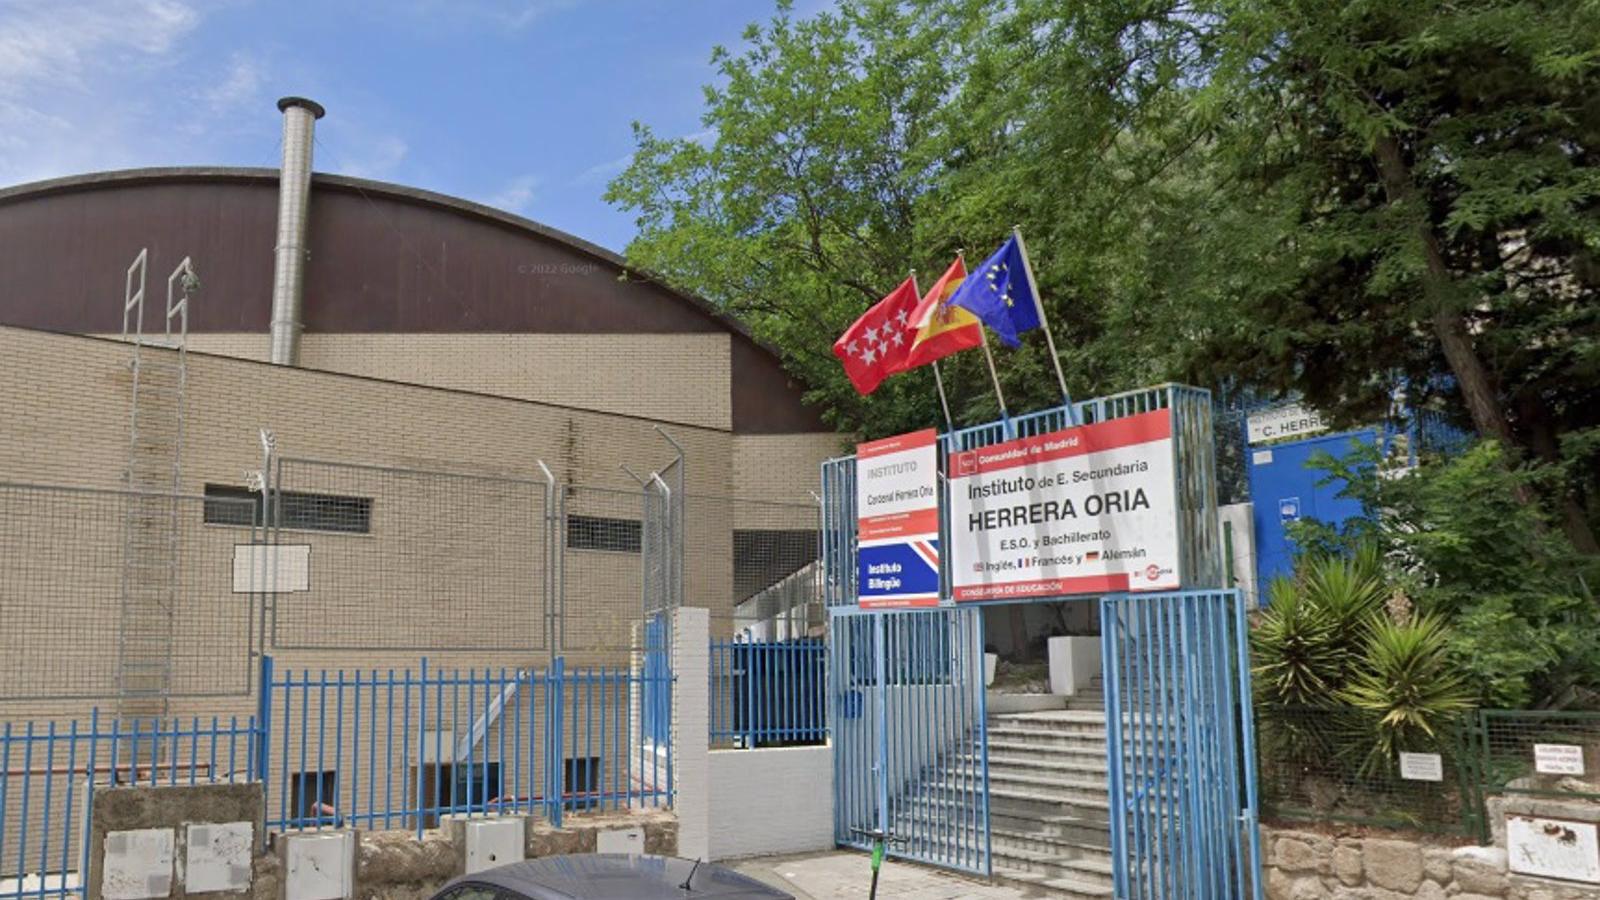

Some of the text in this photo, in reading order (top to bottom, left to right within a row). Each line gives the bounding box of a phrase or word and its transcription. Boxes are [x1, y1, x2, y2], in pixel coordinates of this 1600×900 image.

[979, 447, 1028, 465] Comunidad
[1030, 444, 1042, 454] de
[1044, 436, 1079, 452] Madrid
[867, 460, 918, 480] INSTITUTO
[968, 460, 1149, 499] Instituto de E. Secundaria
[867, 485, 934, 506] Cardenal Herrera Oria
[968, 487, 1151, 532] HERRERA ORIA
[1000, 529, 1111, 550] E.S.O. y Bachillerato
[868, 562, 902, 575] Instituto
[985, 547, 1147, 573] Inglés, Francés y Alemán
[868, 577, 902, 591] Bilingüe
[1005, 584, 1016, 595] DE
